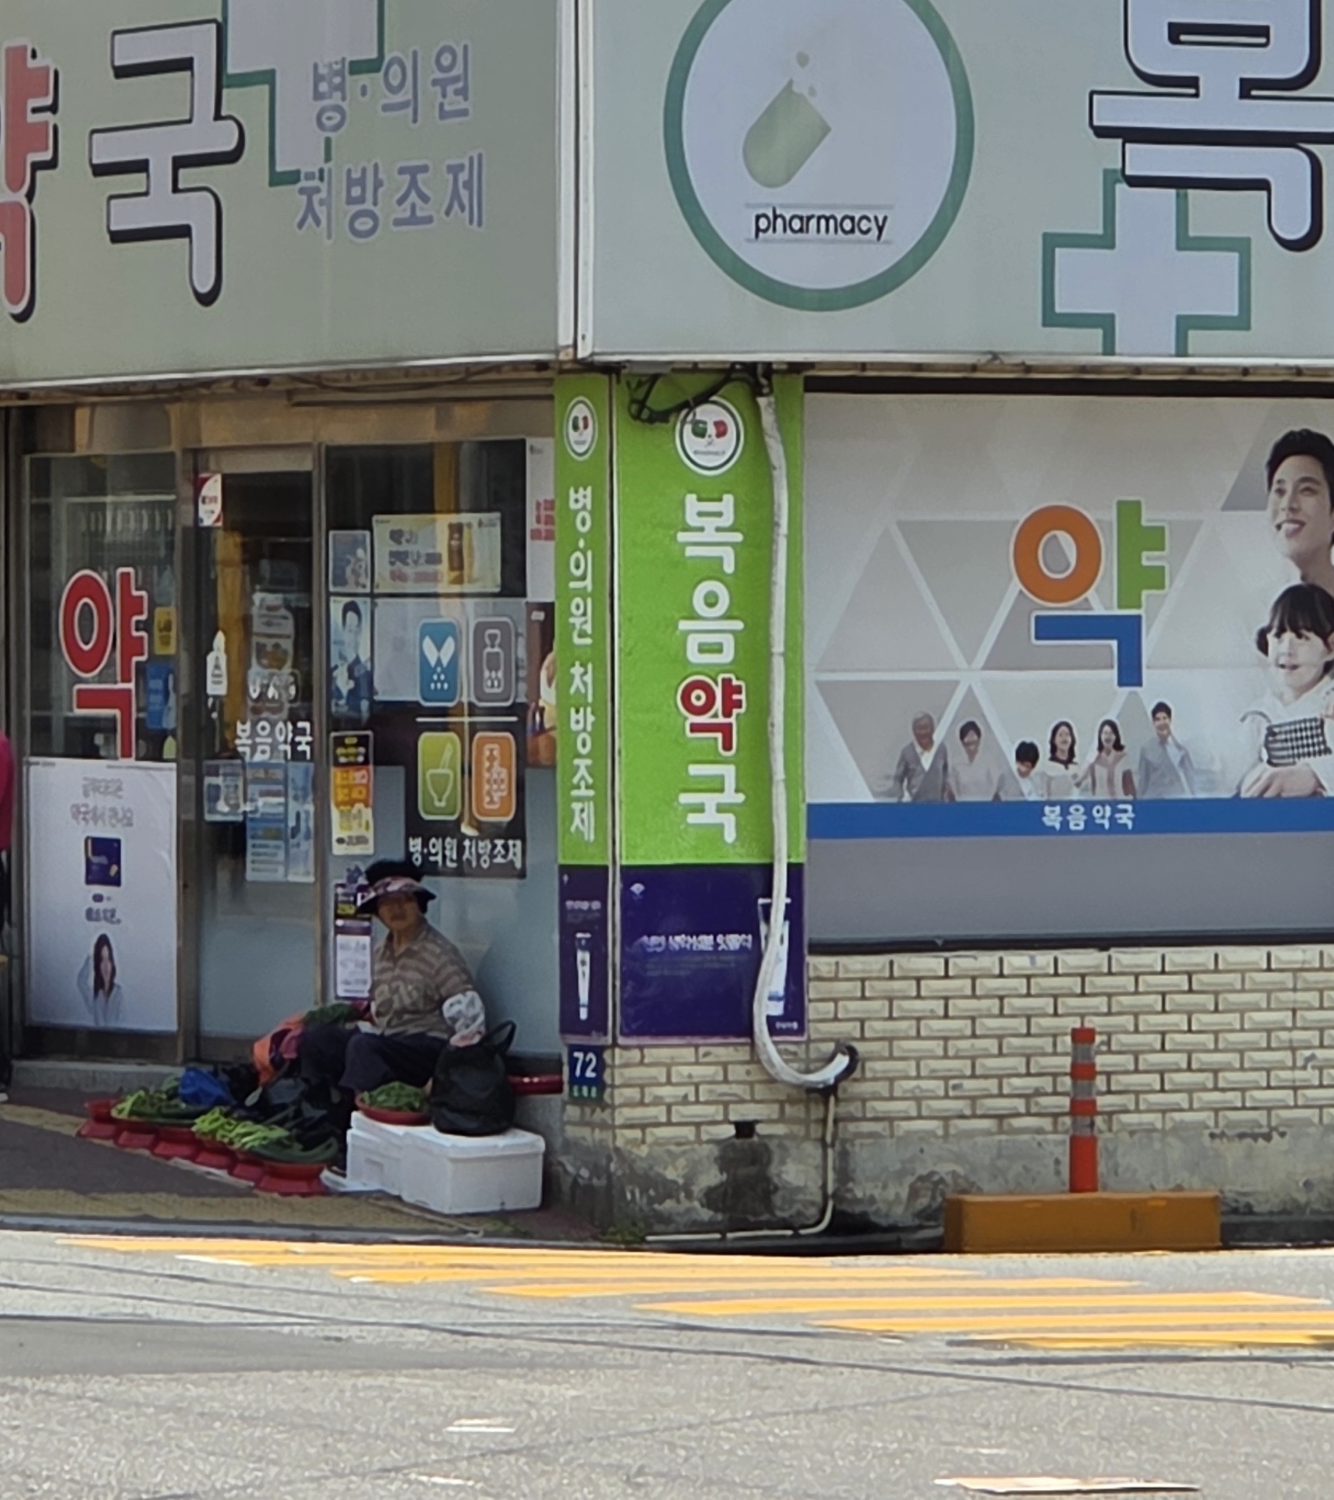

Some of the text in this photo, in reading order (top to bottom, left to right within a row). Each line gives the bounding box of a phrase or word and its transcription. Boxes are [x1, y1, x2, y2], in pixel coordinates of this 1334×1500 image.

[295, 153, 485, 242] 처방조제
[753, 207, 889, 241] pharmacy
[1012, 498, 1167, 689] 약
[59, 567, 148, 760] 약
[676, 493, 747, 844] 복음약국
[235, 720, 313, 761] 복음약국
[569, 661, 595, 843] 처방조제
[1041, 804, 1136, 830] 복음약국
[573, 1051, 597, 1078] 72
